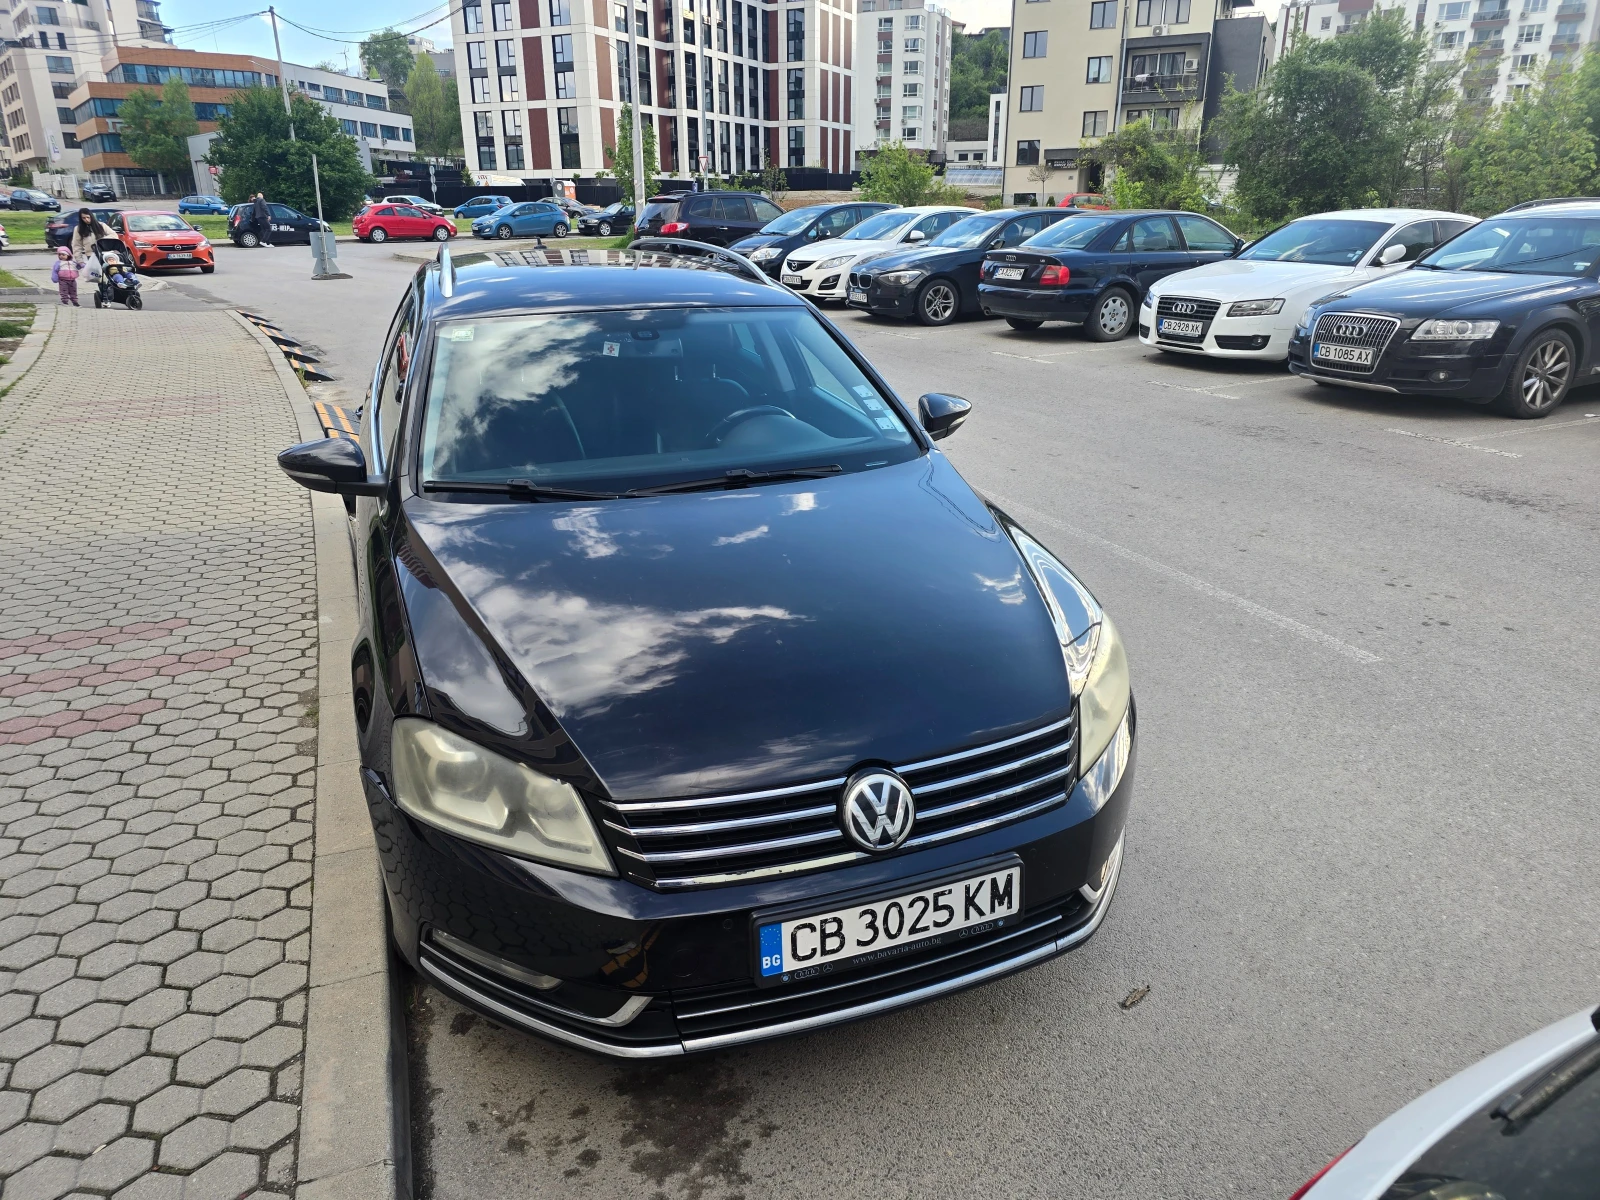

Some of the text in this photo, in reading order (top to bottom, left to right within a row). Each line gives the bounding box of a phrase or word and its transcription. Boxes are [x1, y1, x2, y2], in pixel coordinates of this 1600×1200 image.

[1164, 320, 1200, 333] CB 2928 XK
[1319, 345, 1371, 363] CB 1085 AX
[790, 873, 1013, 963] CB 3025 KM
[852, 937, 942, 965] www.bavaria-auto.bg
[762, 954, 781, 969] BG
